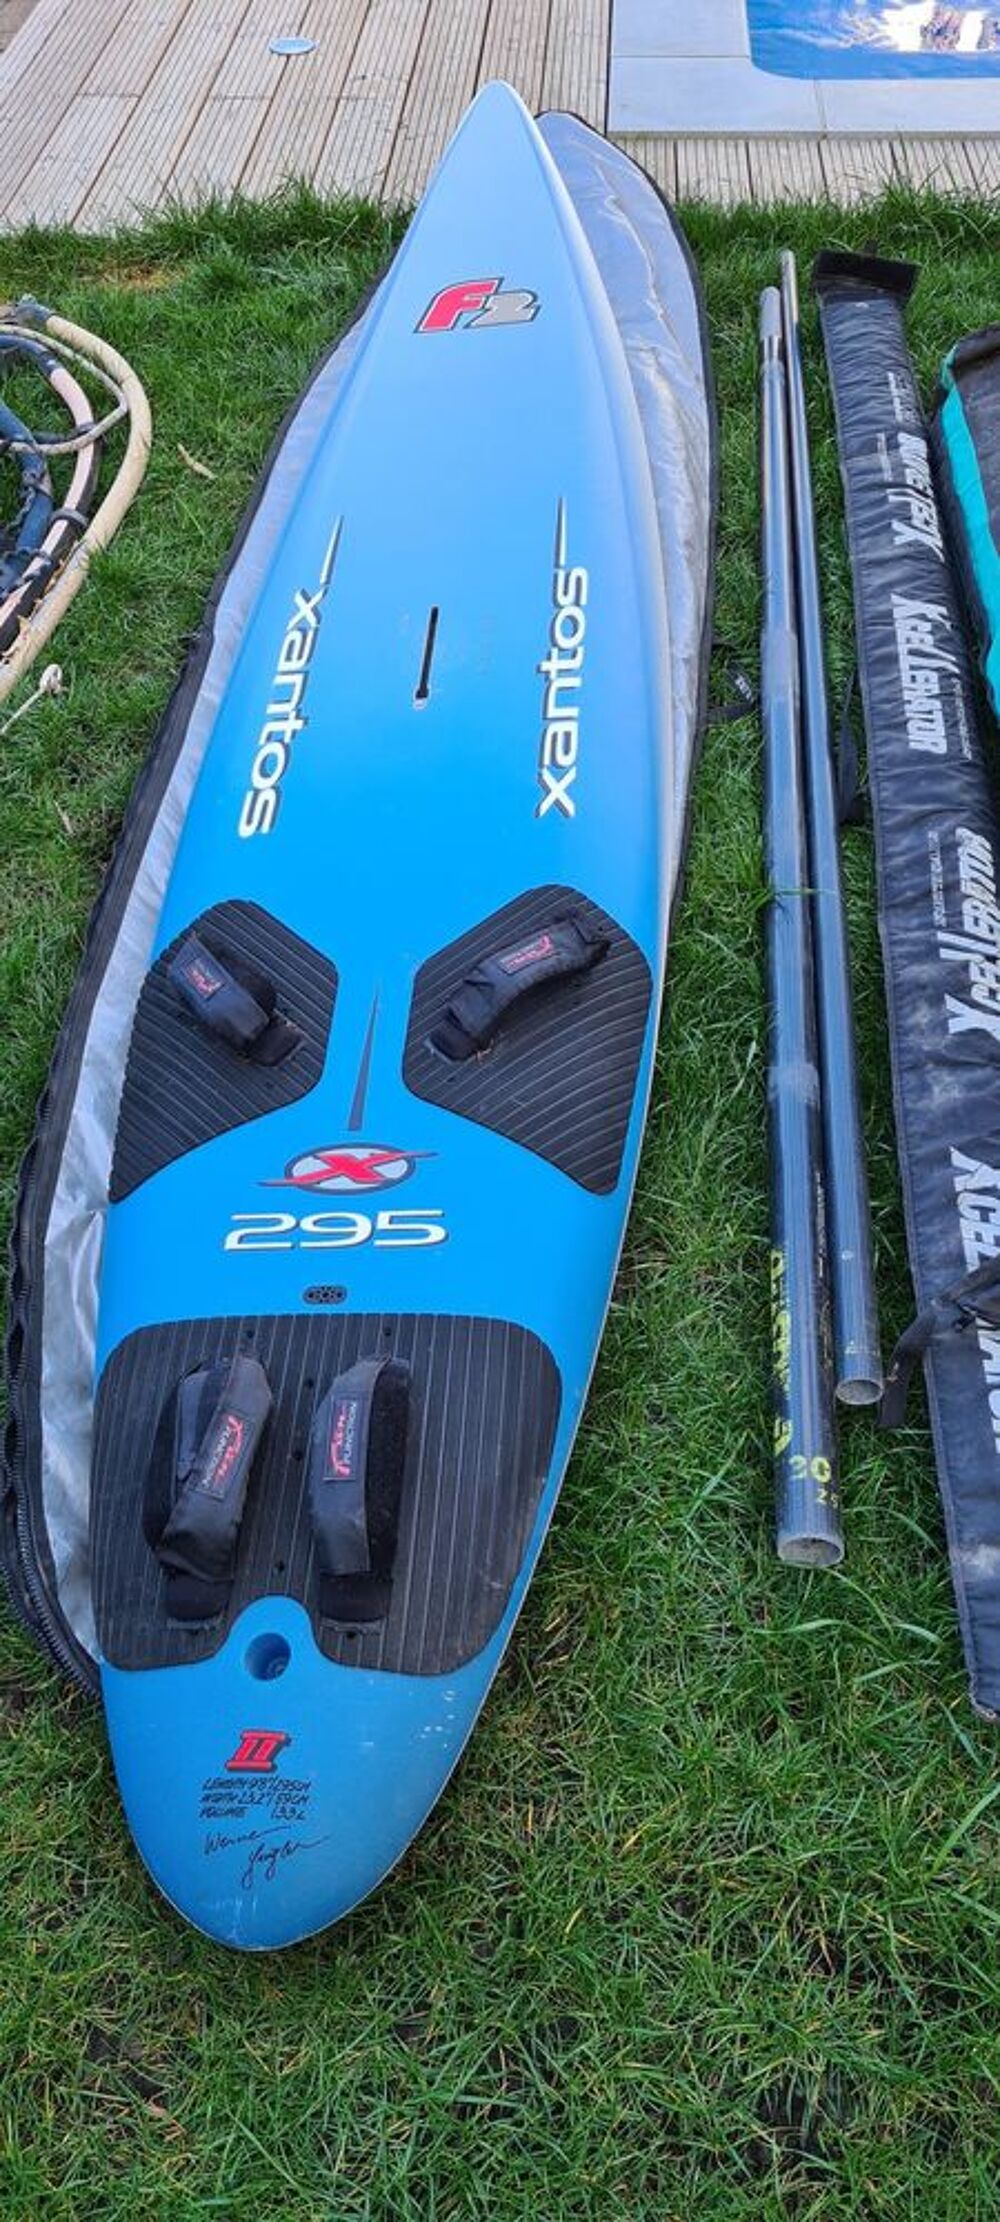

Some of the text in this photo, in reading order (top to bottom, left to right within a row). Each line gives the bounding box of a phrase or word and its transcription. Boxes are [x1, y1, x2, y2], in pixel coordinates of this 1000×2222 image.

[413, 276, 542, 334] F2
[237, 583, 328, 839] xantos
[535, 564, 591, 820] xantos
[223, 1208, 449, 1252] 295
